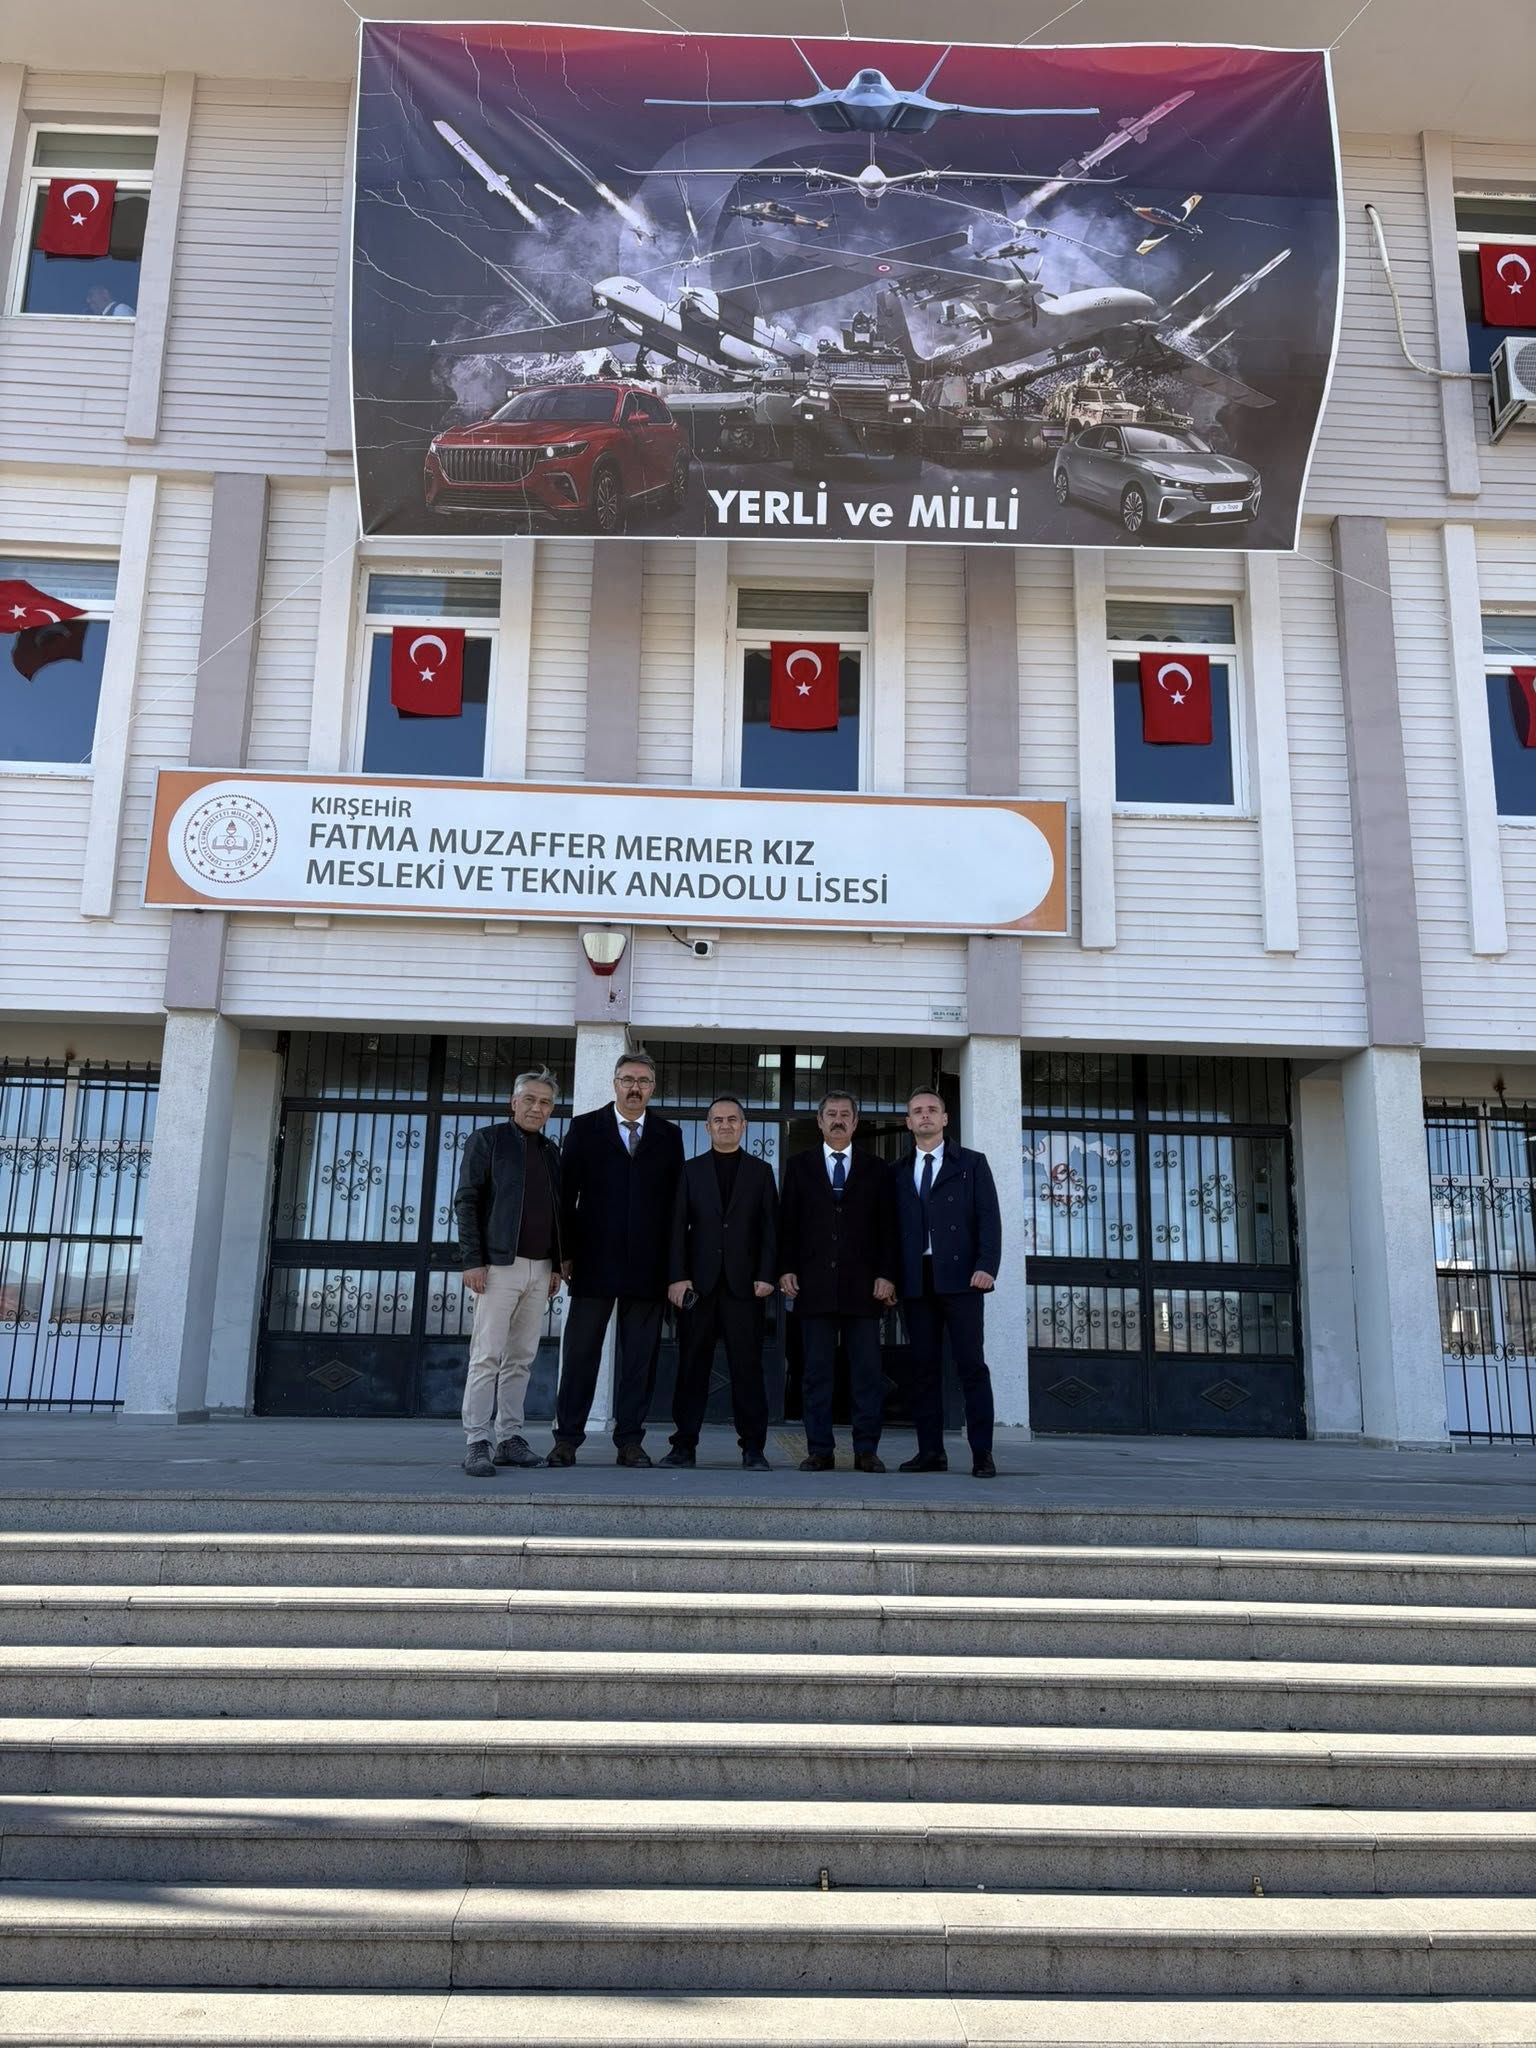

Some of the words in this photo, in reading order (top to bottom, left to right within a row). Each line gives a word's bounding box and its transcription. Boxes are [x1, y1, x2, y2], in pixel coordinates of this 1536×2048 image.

[708, 481, 828, 525] YERLİ
[843, 502, 894, 527] ve
[908, 485, 1019, 530] MİLLİ
[311, 796, 412, 820] KIRŞEHİR
[309, 823, 419, 853] FATMA
[428, 827, 606, 860] MUZAFFER
[615, 835, 753, 865] MERMER
[763, 839, 815, 866] KIZ
[306, 857, 445, 890] MESLEKİ
[453, 864, 494, 892] VE
[500, 863, 617, 896] TEKNİK
[625, 871, 787, 901] ANADOLU
[797, 871, 888, 904] LİSESİ
